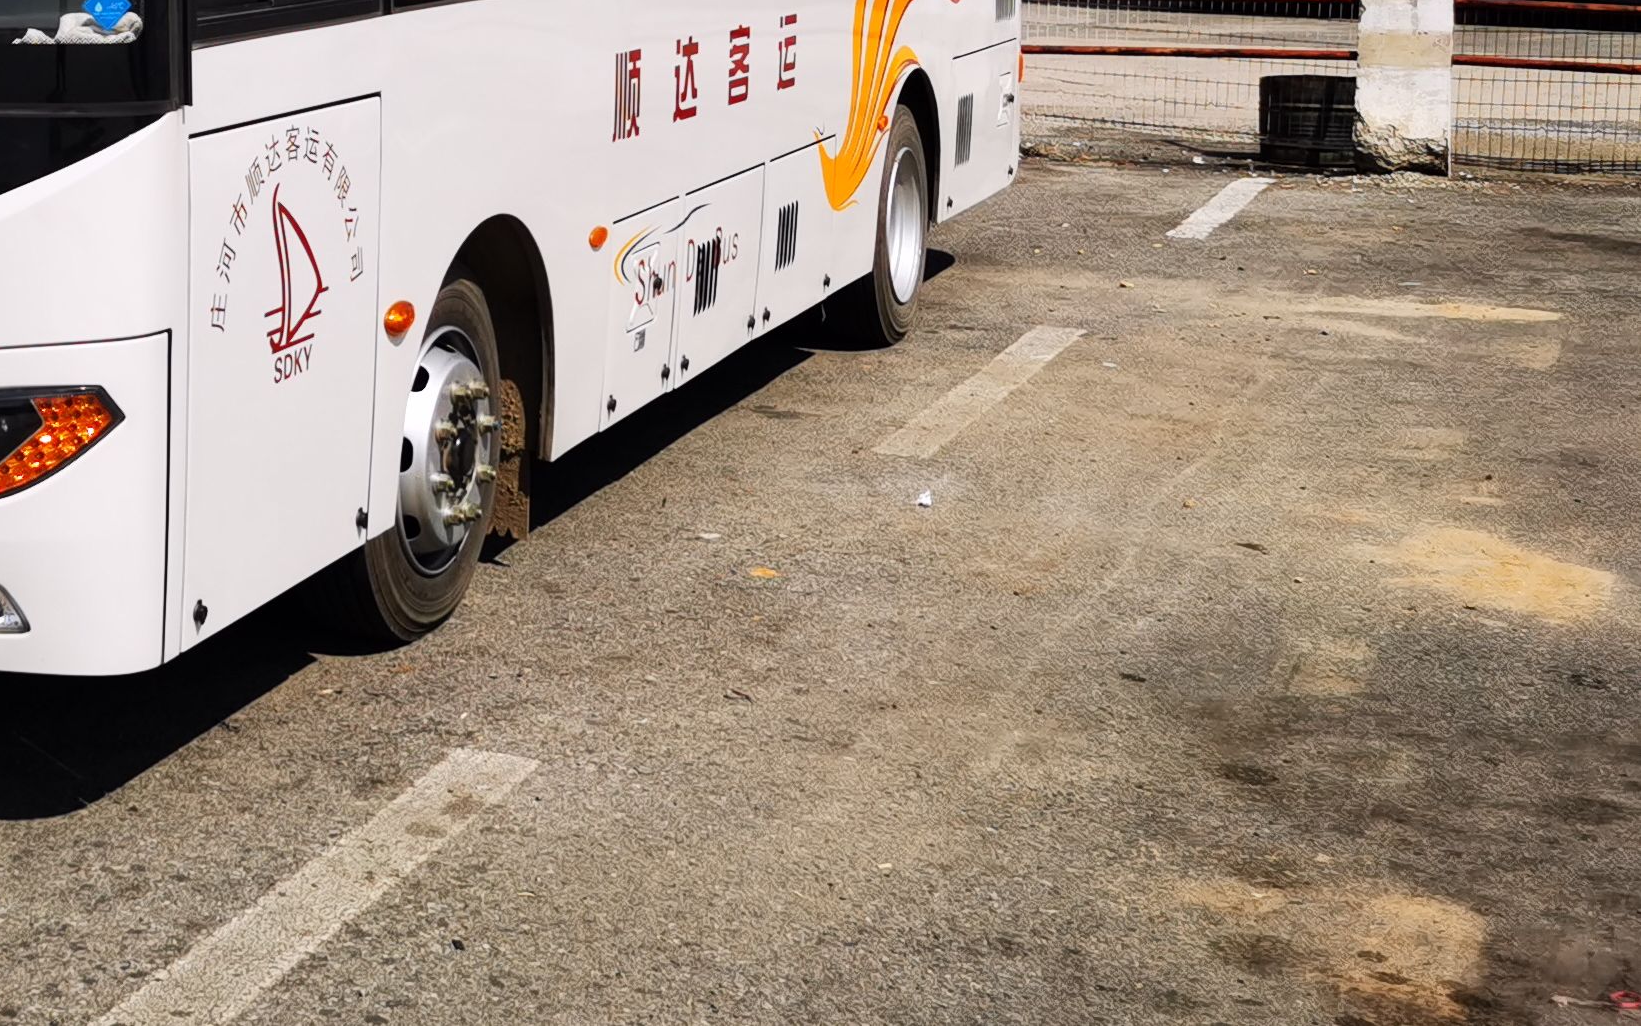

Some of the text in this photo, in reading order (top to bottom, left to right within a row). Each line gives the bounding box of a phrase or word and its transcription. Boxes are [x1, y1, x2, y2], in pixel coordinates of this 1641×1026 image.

[612, 13, 798, 142] 顺达客运
[210, 124, 364, 333] 庄河市顺达客运有限公司
[273, 344, 313, 384] SDKY
